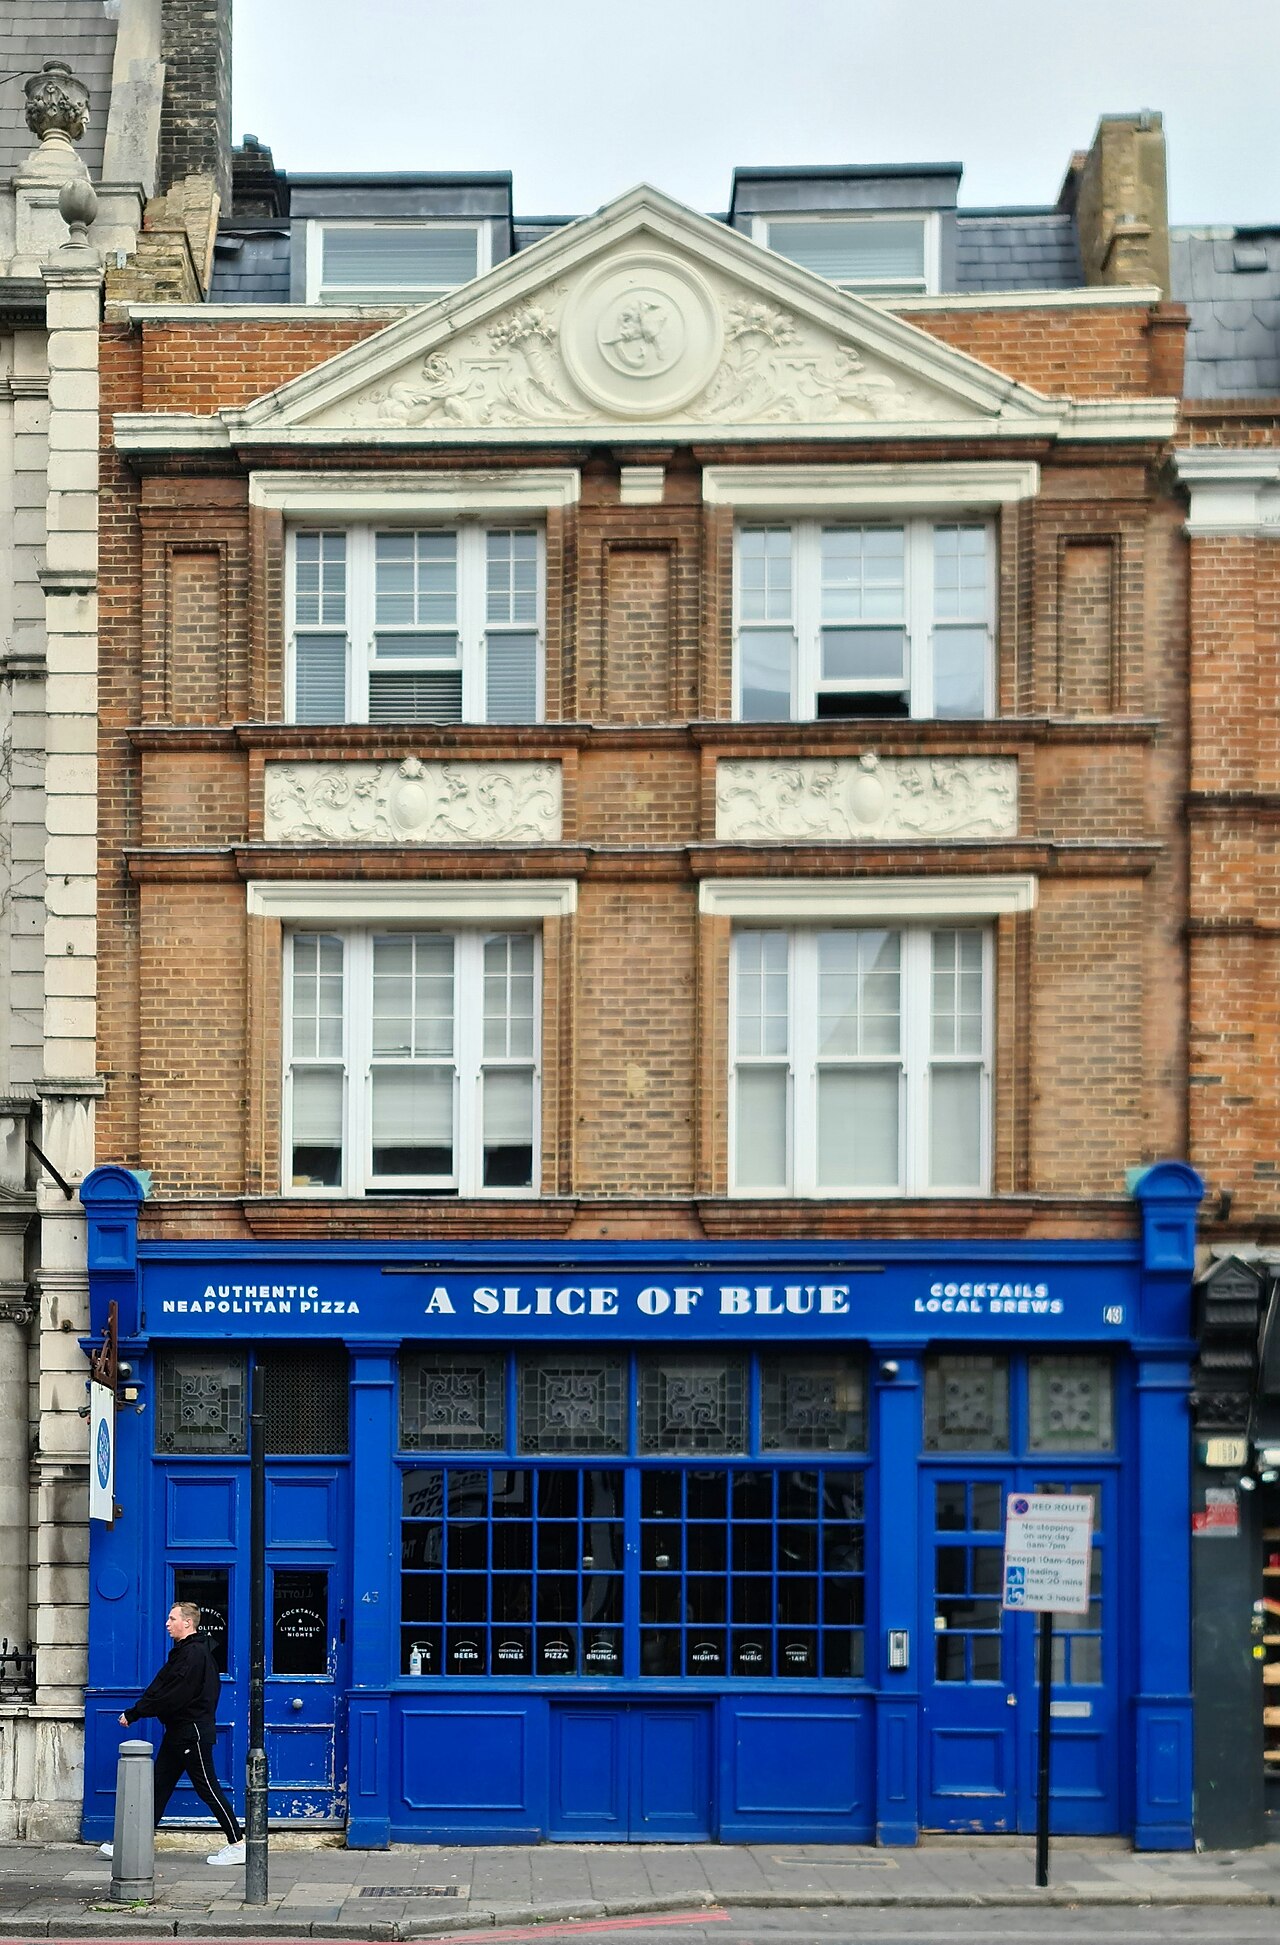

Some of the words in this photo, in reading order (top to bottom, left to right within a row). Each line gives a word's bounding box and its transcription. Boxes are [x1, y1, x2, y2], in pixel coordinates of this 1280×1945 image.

[203, 1285, 319, 1298] AUTHENTIC
[930, 1283, 1049, 1298] COCKTAILS
[424, 1287, 457, 1315] A
[472, 1287, 620, 1315] SLICE
[636, 1286, 704, 1315] OF
[718, 1286, 850, 1315] BLUE
[914, 1298, 983, 1313] LOCAL
[989, 1299, 1064, 1314] BREWS
[162, 1300, 291, 1314] NEAPOLITAN
[300, 1301, 361, 1314] PIZZA
[1105, 1306, 1120, 1324] 43
[1032, 1503, 1051, 1511] RED
[1054, 1503, 1087, 1512] ROUTE
[1021, 1522, 1033, 1530] No
[1036, 1523, 1074, 1532] stopping
[1037, 1533, 1052, 1541] any
[1055, 1533, 1070, 1541] day
[1007, 1555, 1036, 1564] Except
[1027, 1568, 1059, 1577] loading
[1047, 1577, 1060, 1585] 20
[361, 1591, 379, 1603] 43
[1047, 1593, 1053, 1601] 3
[1056, 1594, 1081, 1602] hours
[200, 1607, 221, 1618] ENTIC
[281, 1608, 319, 1619] COCKTAILS
